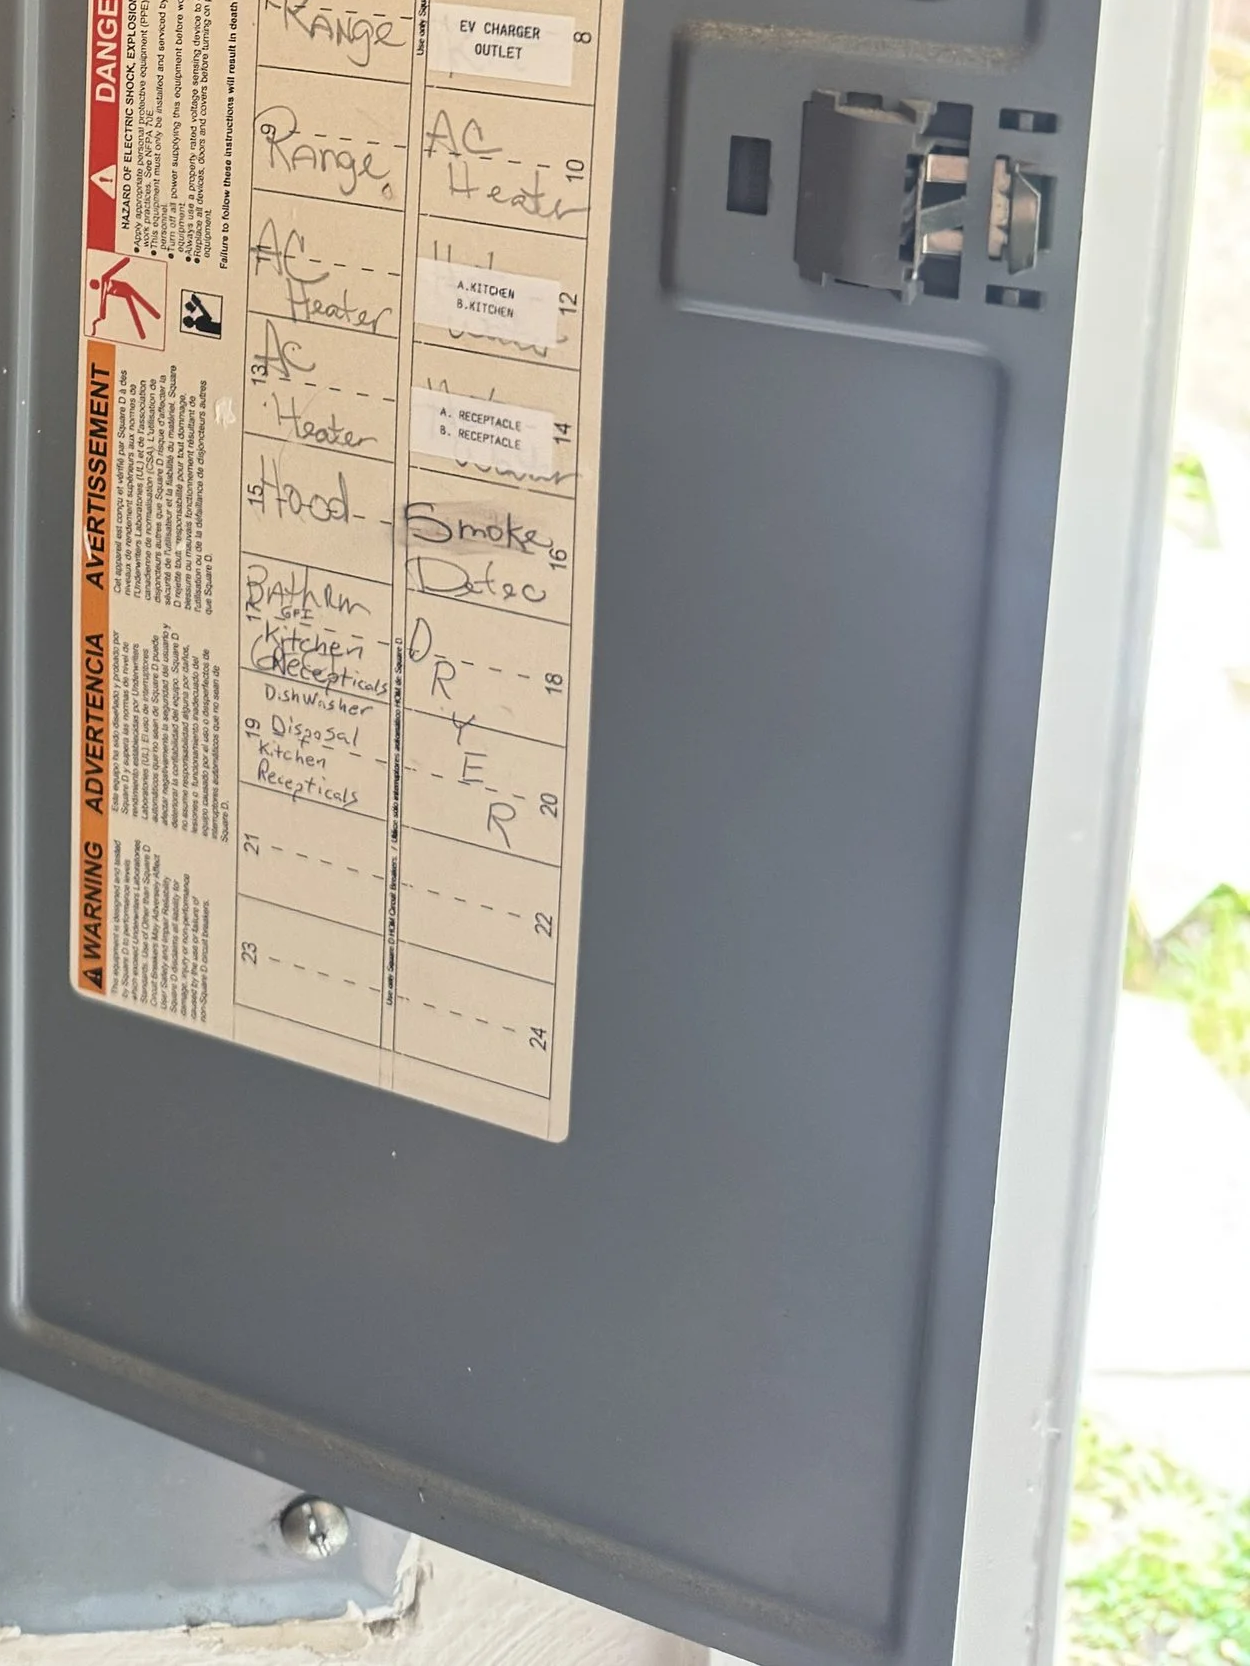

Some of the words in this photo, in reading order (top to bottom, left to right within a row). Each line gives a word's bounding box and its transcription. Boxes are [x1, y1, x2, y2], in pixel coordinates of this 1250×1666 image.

[459, 19, 478, 33] EV
[483, 21, 541, 40] CHARGER
[572, 31, 592, 45] 8
[473, 43, 523, 60] OUTLET
[123, 109, 134, 163] ELECTRIC
[426, 110, 503, 159] AC
[122, 167, 133, 180] OF
[566, 159, 585, 182] 10
[121, 185, 132, 229] HAZARD
[250, 218, 330, 284] AC
[286, 278, 392, 334] Heater
[560, 292, 578, 315] 12
[255, 319, 315, 378] AC
[272, 392, 377, 449] Heater
[440, 408, 452, 419] A.
[458, 409, 523, 433] RECEPTACLE
[554, 422, 572, 444] 14
[439, 426, 452, 437] B.
[457, 428, 522, 451] RECEPTACLE
[87, 363, 110, 590] AVERTISSEMENT
[549, 548, 567, 570] 16
[545, 671, 563, 695] 18
[84, 633, 106, 815] ADVERTENCIA
[540, 792, 558, 818] 20
[243, 832, 260, 856] 21
[82, 841, 103, 962] WARNING
[535, 911, 554, 938] 22
[241, 941, 258, 965] 23
[529, 1026, 548, 1052] 24
